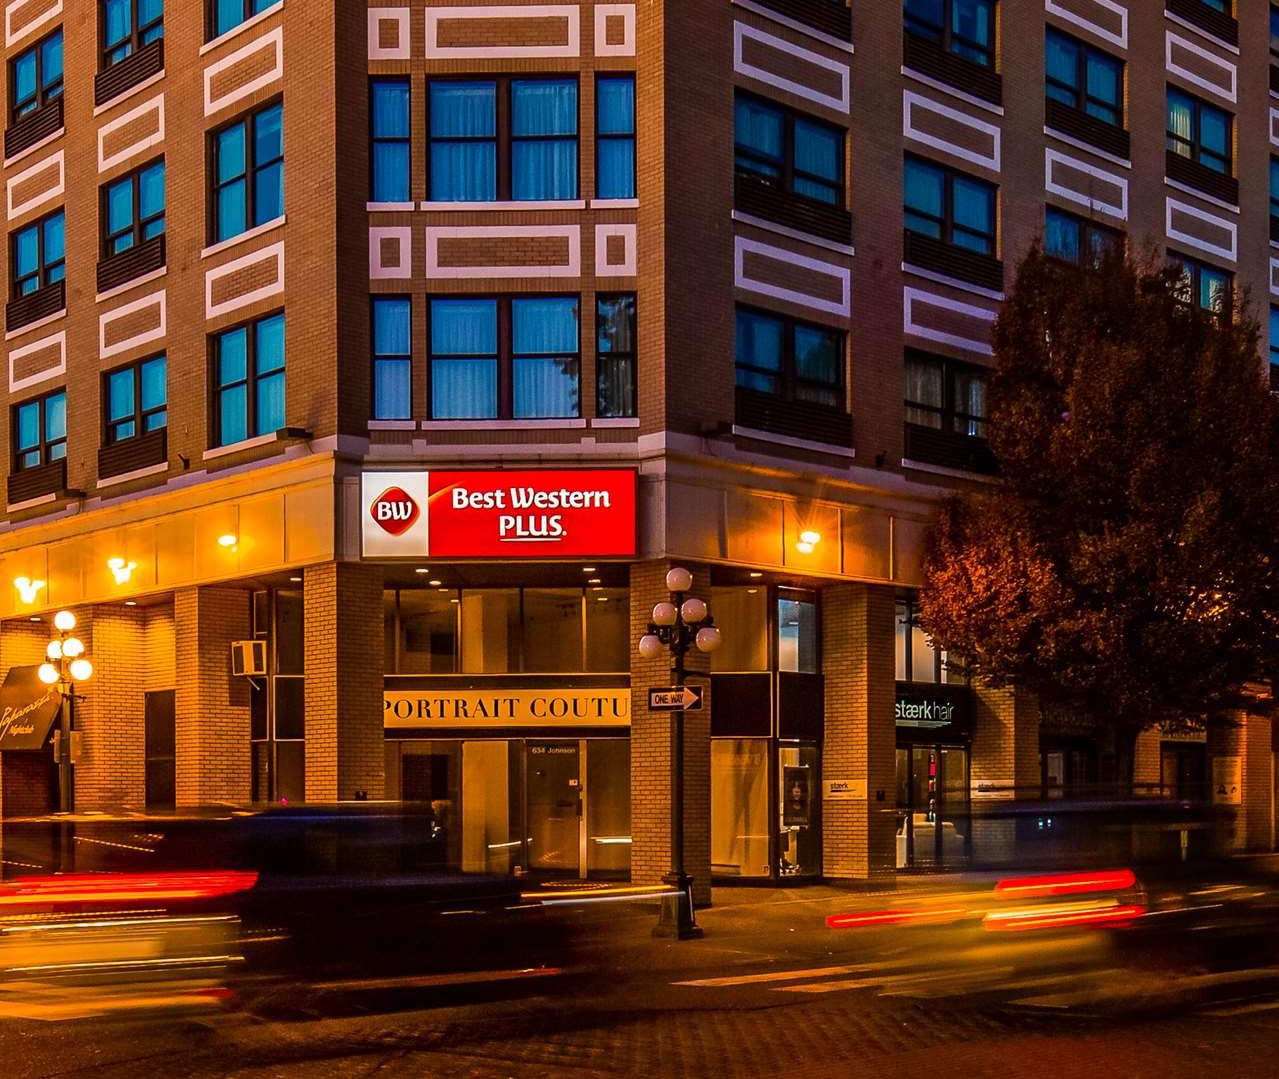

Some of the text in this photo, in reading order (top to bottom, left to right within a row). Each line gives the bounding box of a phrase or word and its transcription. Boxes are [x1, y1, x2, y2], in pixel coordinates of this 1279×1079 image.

[452, 487, 610, 508] Best Western
[377, 501, 412, 521] BW
[654, 693, 684, 705] ONE WAY
[933, 700, 955, 720] hair
